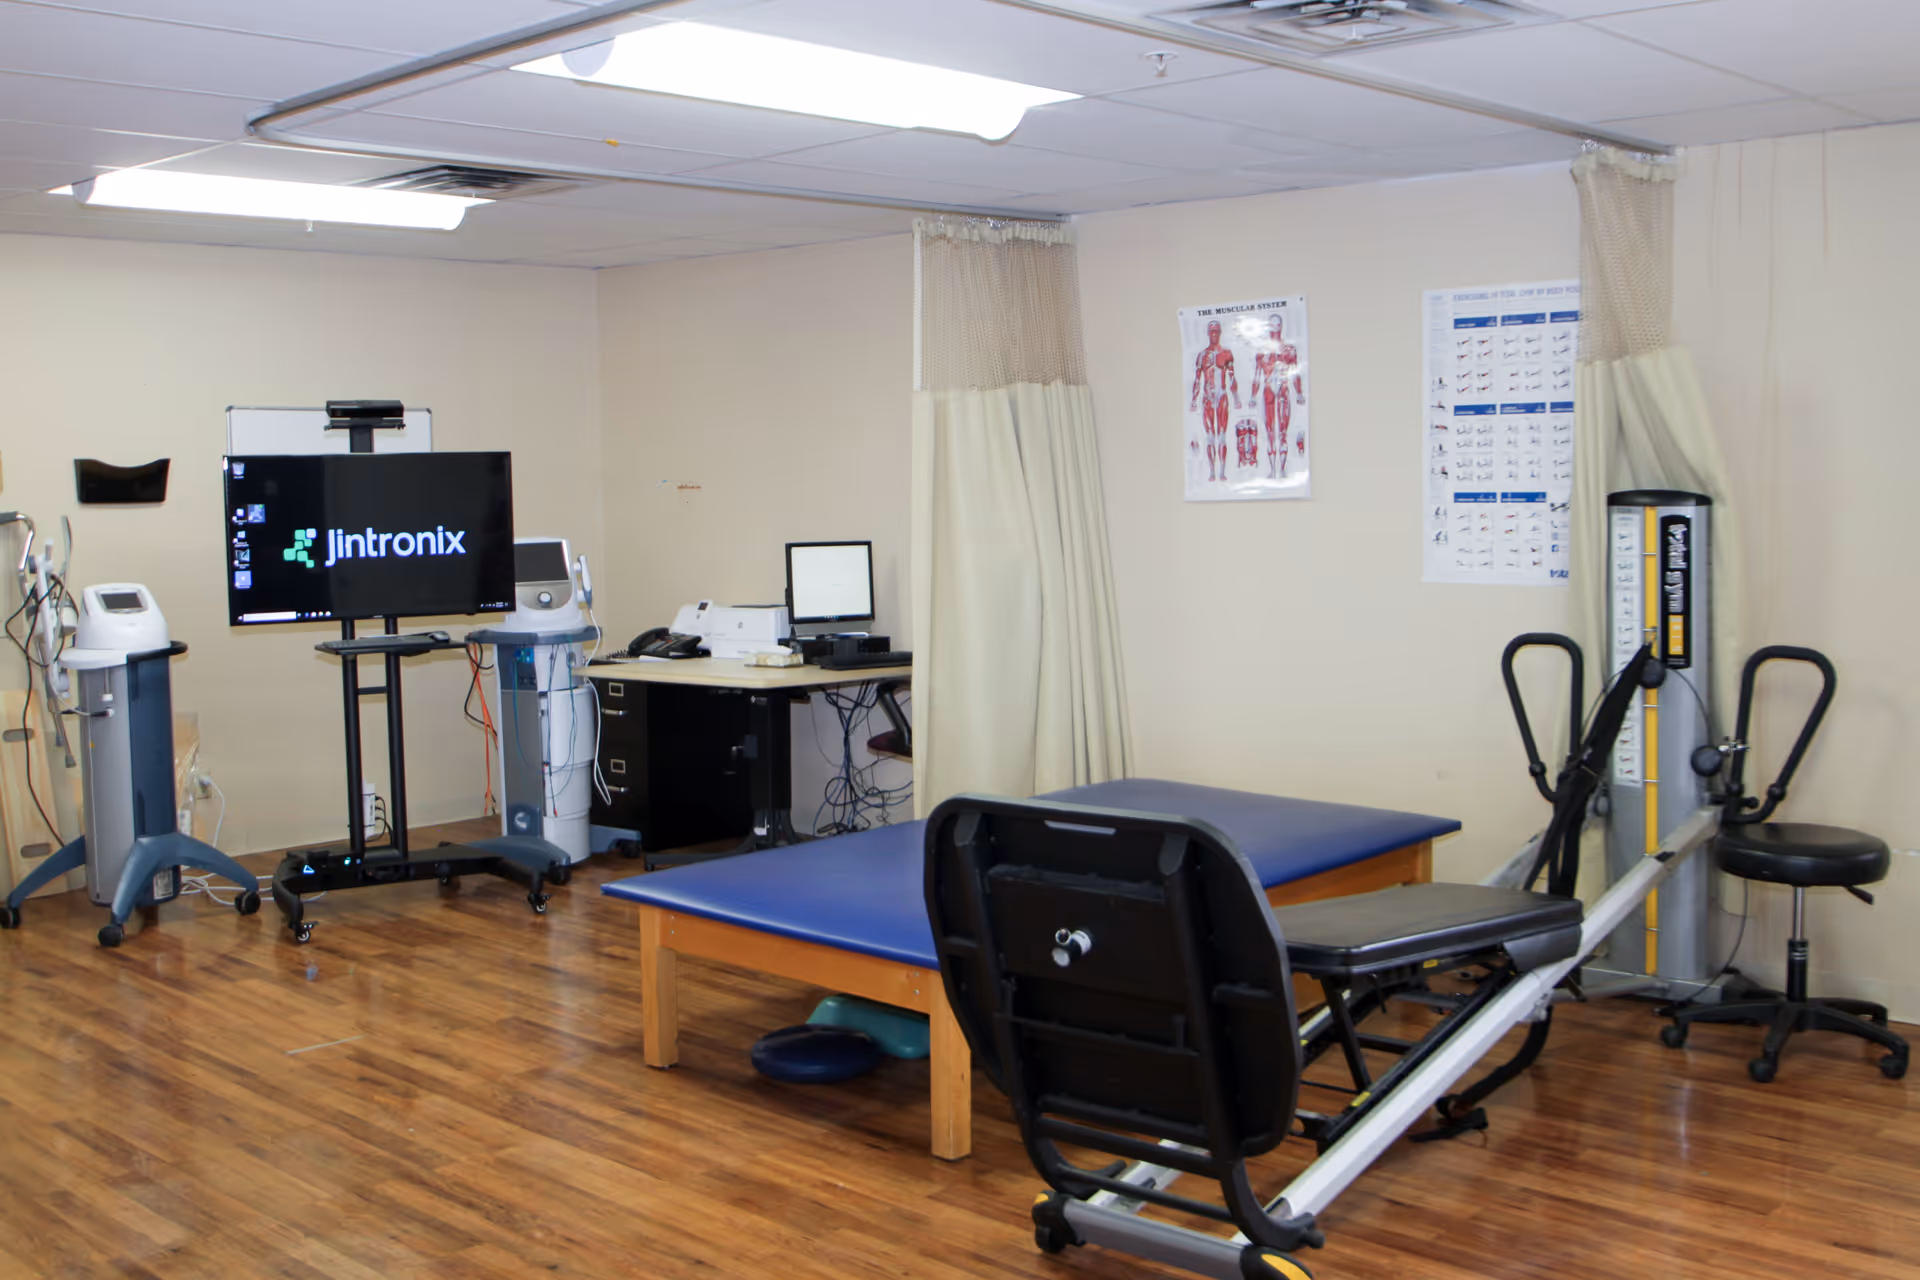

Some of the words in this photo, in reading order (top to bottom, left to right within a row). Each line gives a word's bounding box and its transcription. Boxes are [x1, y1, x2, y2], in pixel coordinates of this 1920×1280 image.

[1197, 309, 1213, 317] THE
[1215, 304, 1255, 315] MUSCULAR
[1257, 300, 1287, 310] SYSTEM
[324, 525, 467, 568] Jintronix
